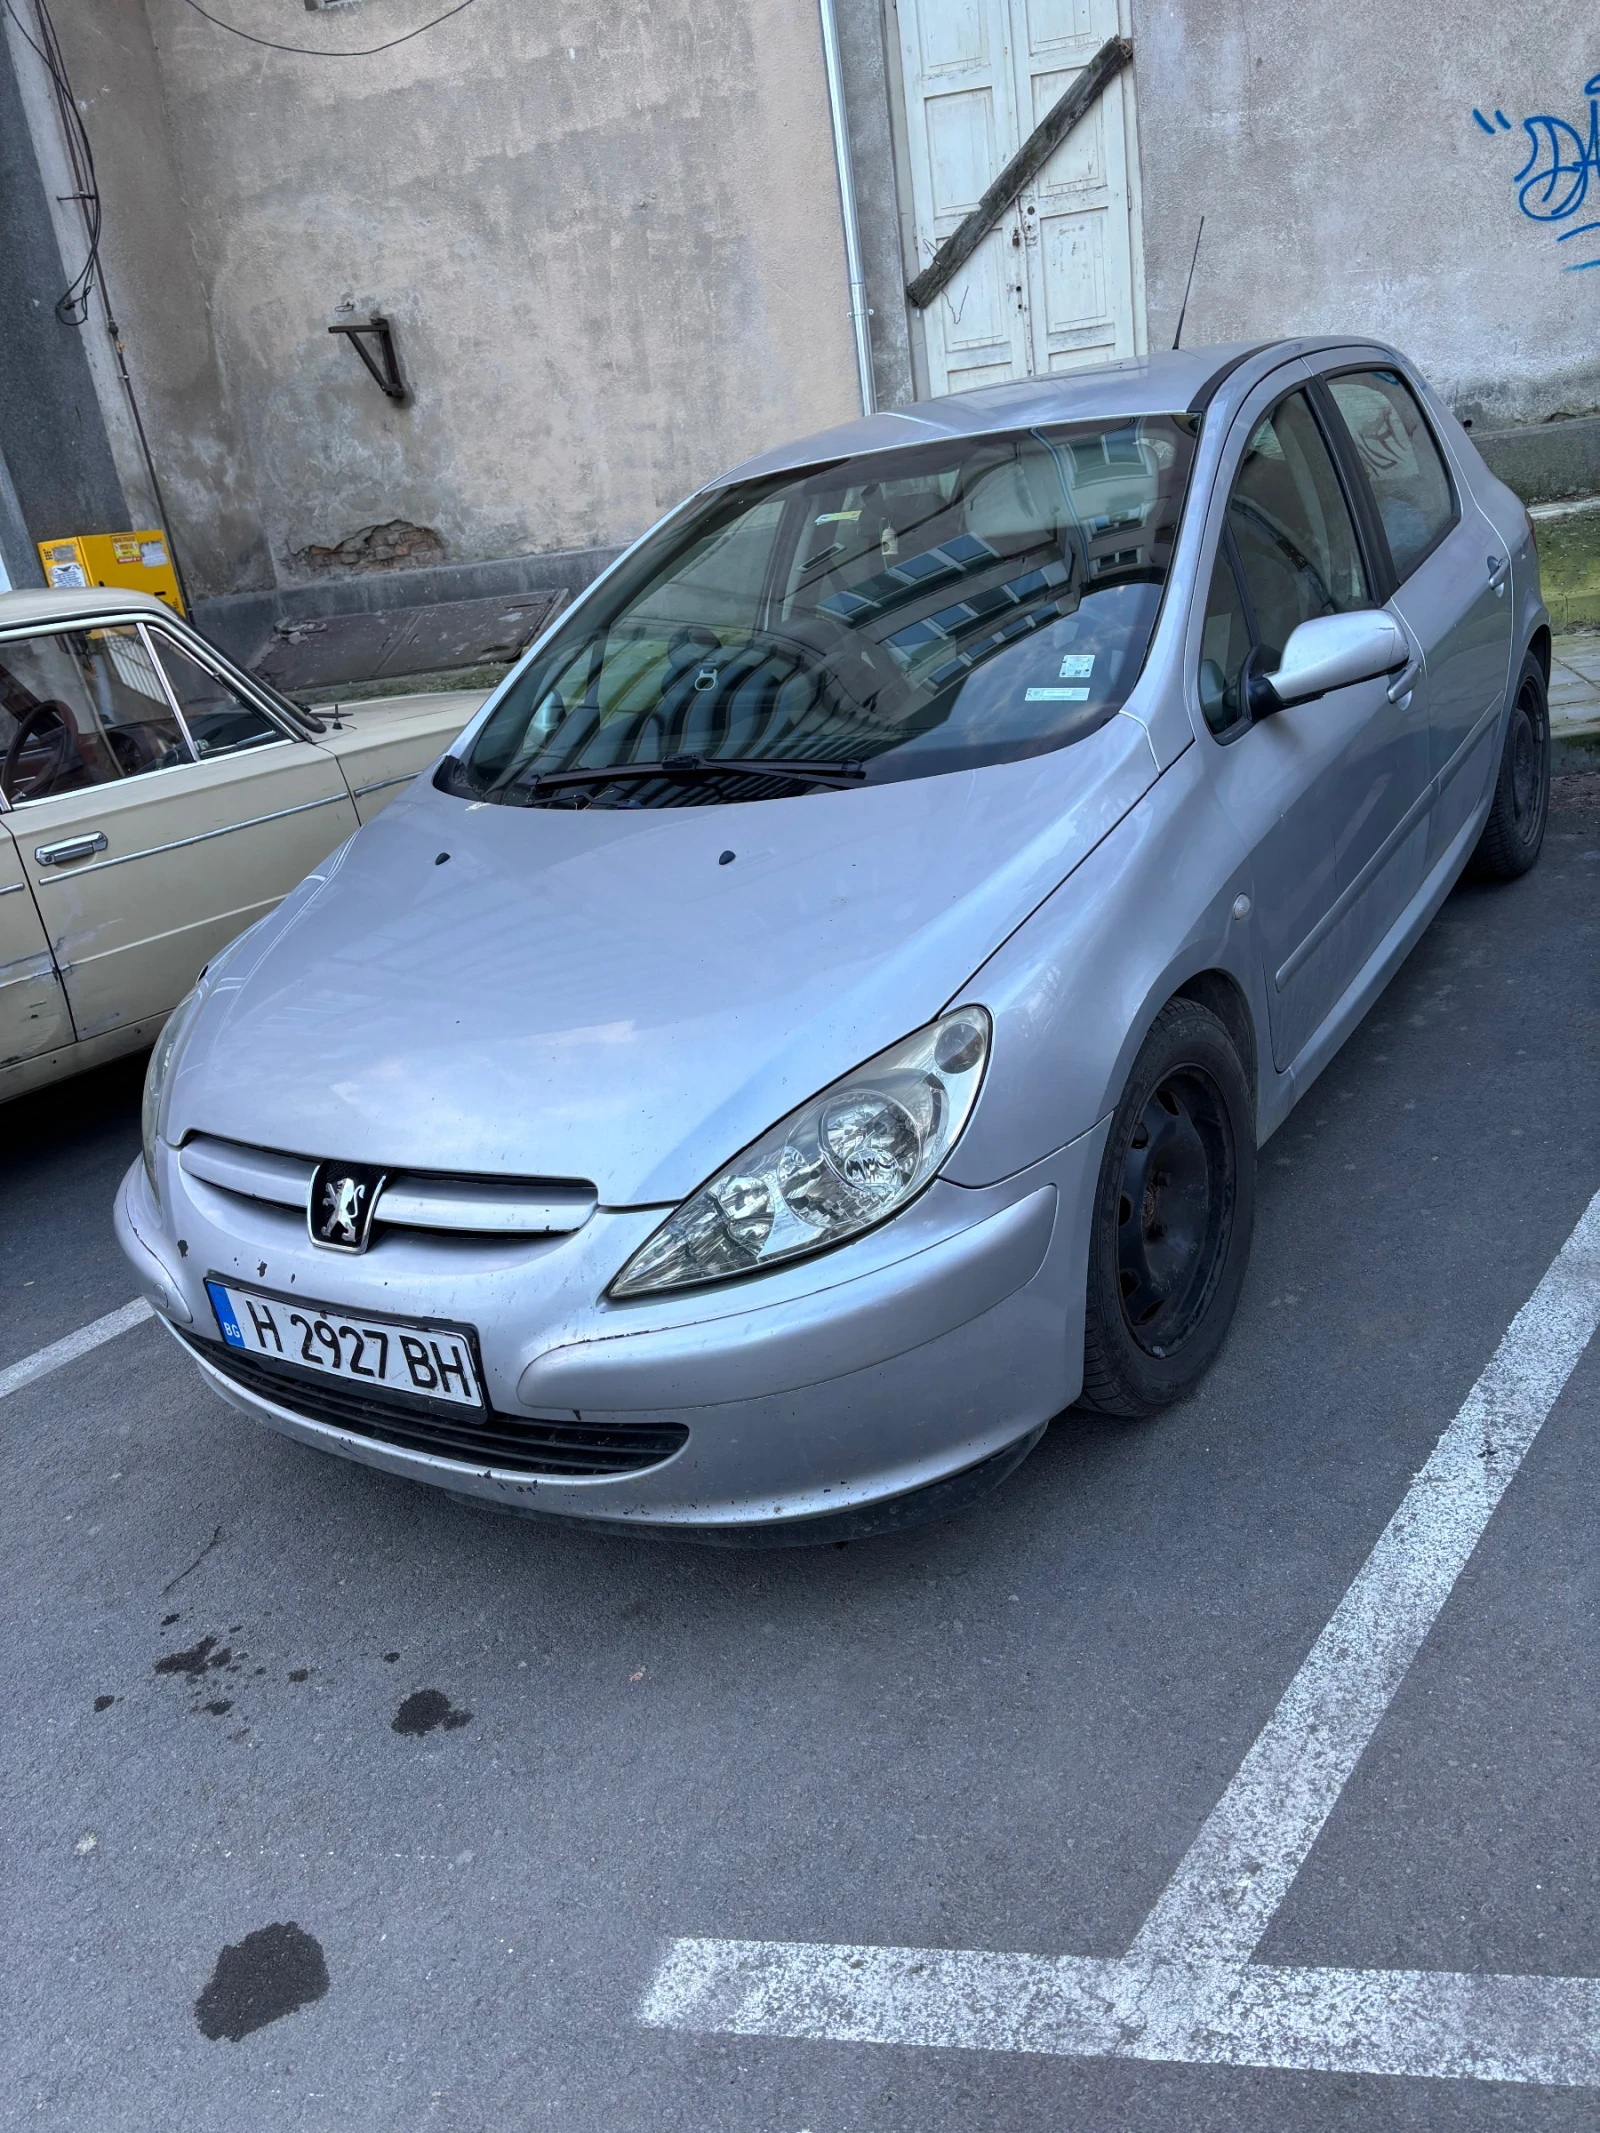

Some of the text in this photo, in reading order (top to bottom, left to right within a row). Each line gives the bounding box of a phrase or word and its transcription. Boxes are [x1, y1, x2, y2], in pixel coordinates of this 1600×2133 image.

[225, 1323, 241, 1339] BG
[246, 1300, 472, 1397] H 2927 BH
